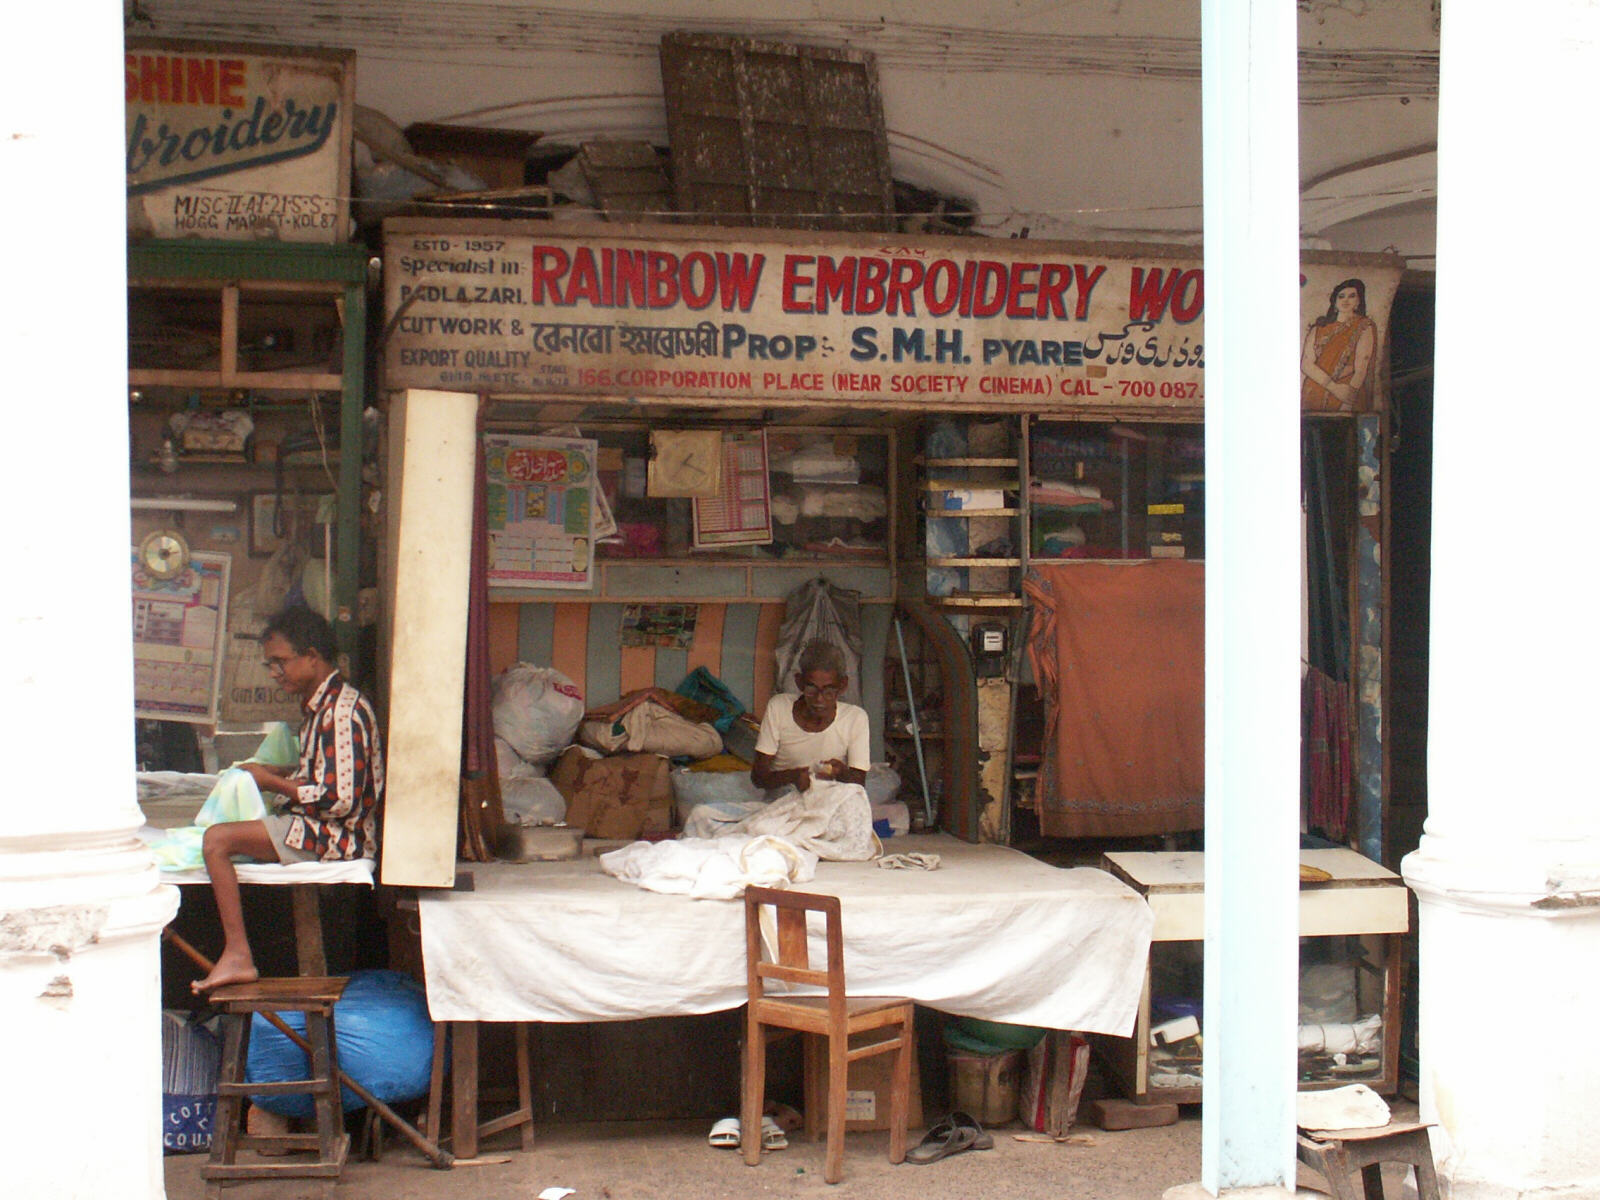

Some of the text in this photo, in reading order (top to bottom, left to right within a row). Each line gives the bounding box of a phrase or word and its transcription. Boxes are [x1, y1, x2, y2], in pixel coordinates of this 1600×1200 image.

[126, 54, 246, 107] SHINE
[127, 96, 337, 174] broidery
[174, 214, 219, 230] HOGG
[400, 256, 494, 276] Specialist
[532, 244, 1204, 325] RAINBOW EMBROIDERY WO
[399, 316, 525, 336] CUTWORK &
[400, 348, 531, 368] EXPORT QUALITY
[983, 338, 1084, 367] PYARE
[763, 372, 825, 391] PLACE
[832, 372, 882, 393] (NEAR
[890, 375, 969, 393] SOCIETY
[979, 374, 1053, 398] CINEMA)
[170, 1102, 214, 1125] COTT
